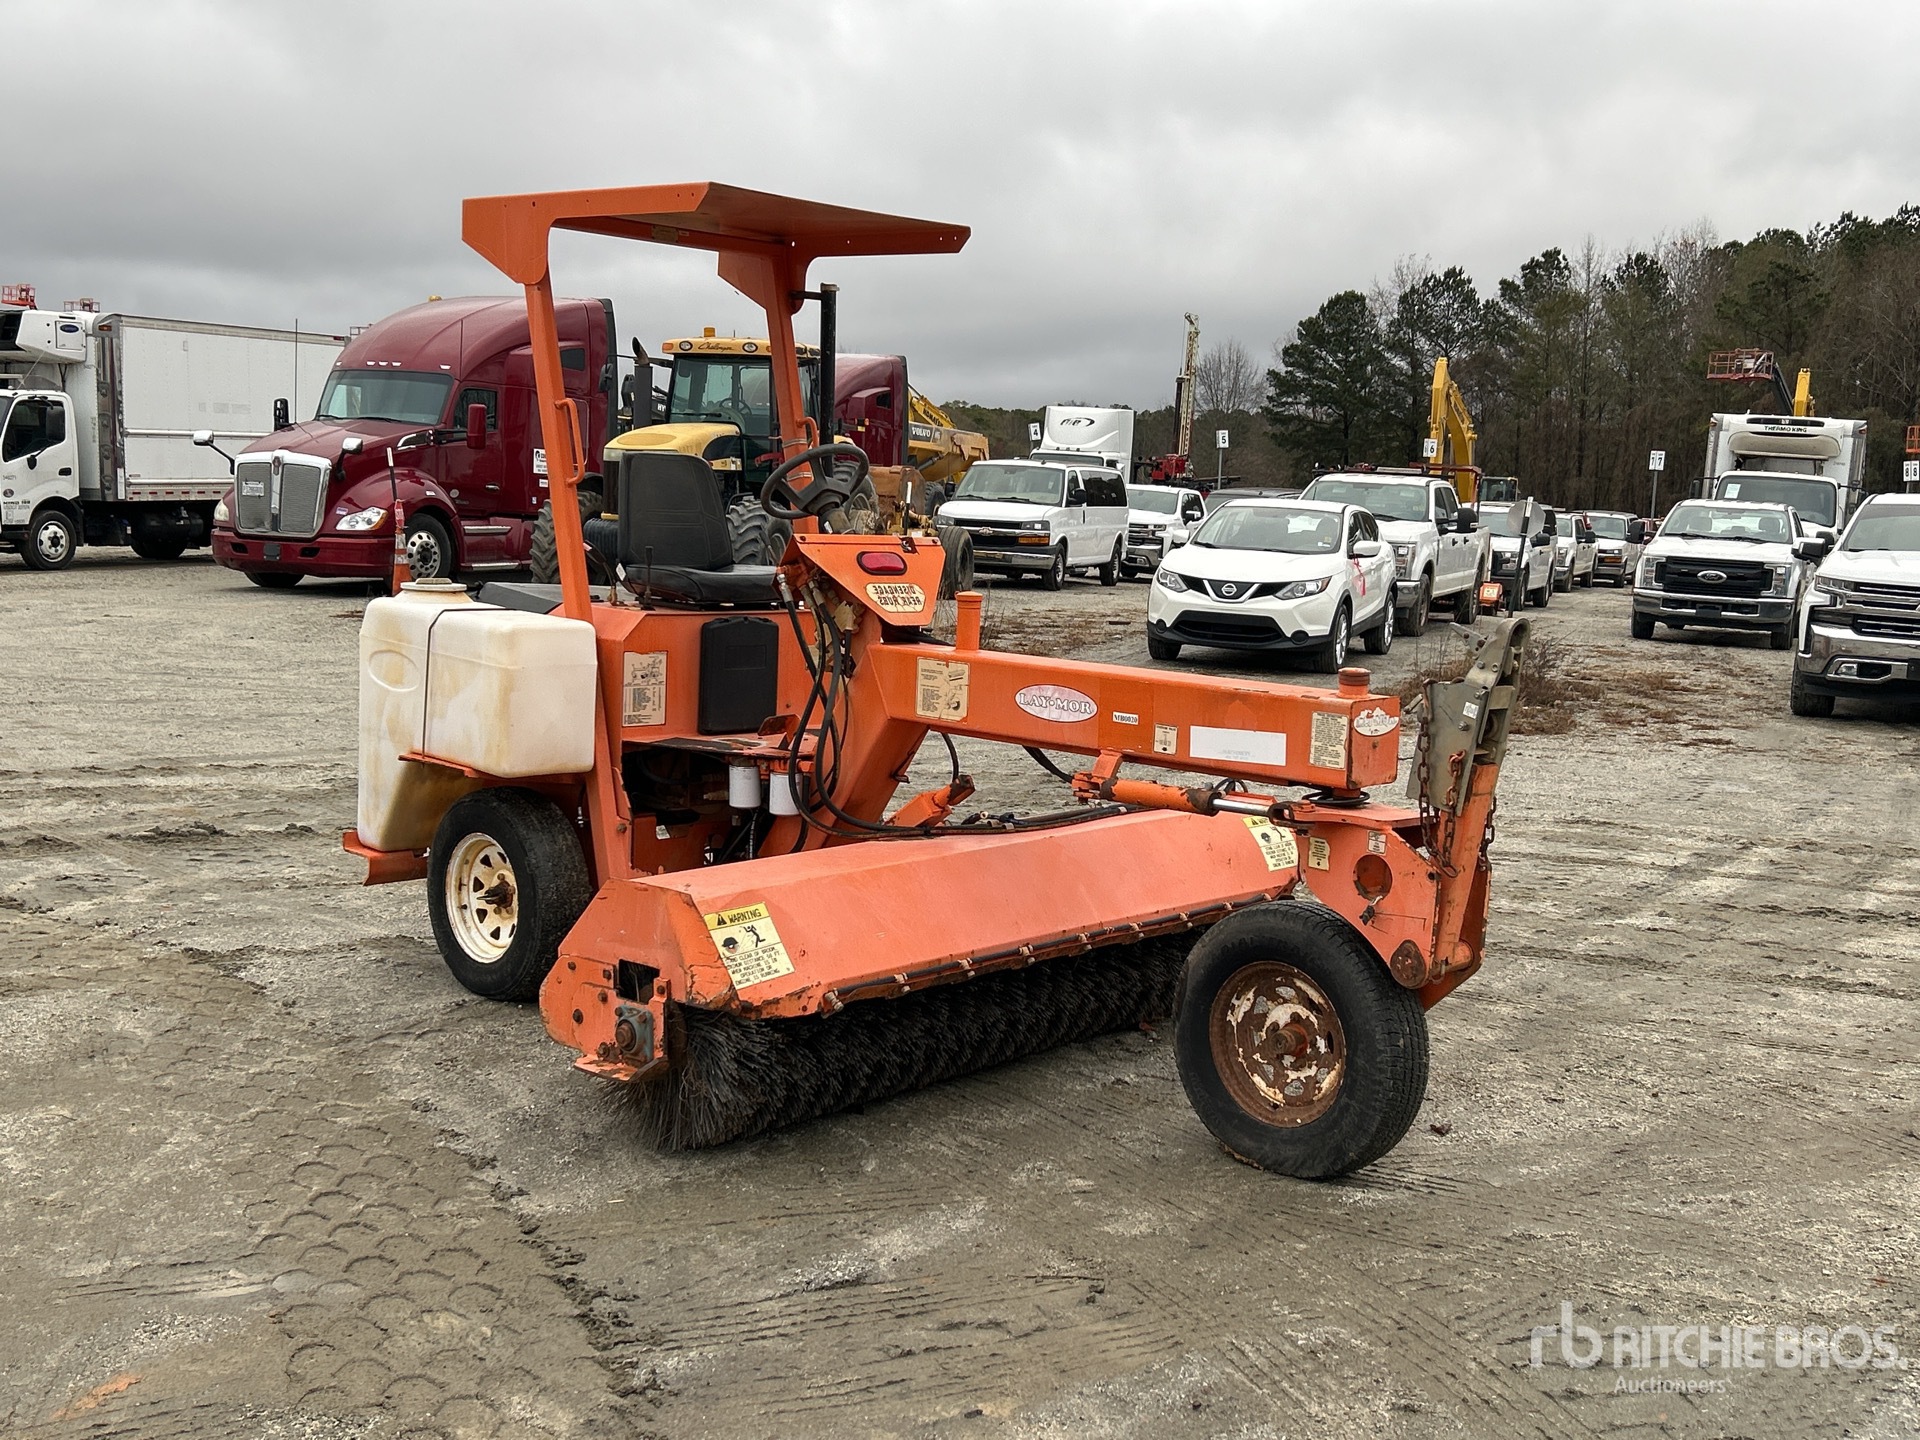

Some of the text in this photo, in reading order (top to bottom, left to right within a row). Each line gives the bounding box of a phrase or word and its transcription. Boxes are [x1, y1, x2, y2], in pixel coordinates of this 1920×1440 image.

[912, 427, 930, 438] VOLVO
[1222, 436, 1226, 444] 5
[1430, 445, 1434, 453] 6
[728, 908, 762, 924] WARNING
